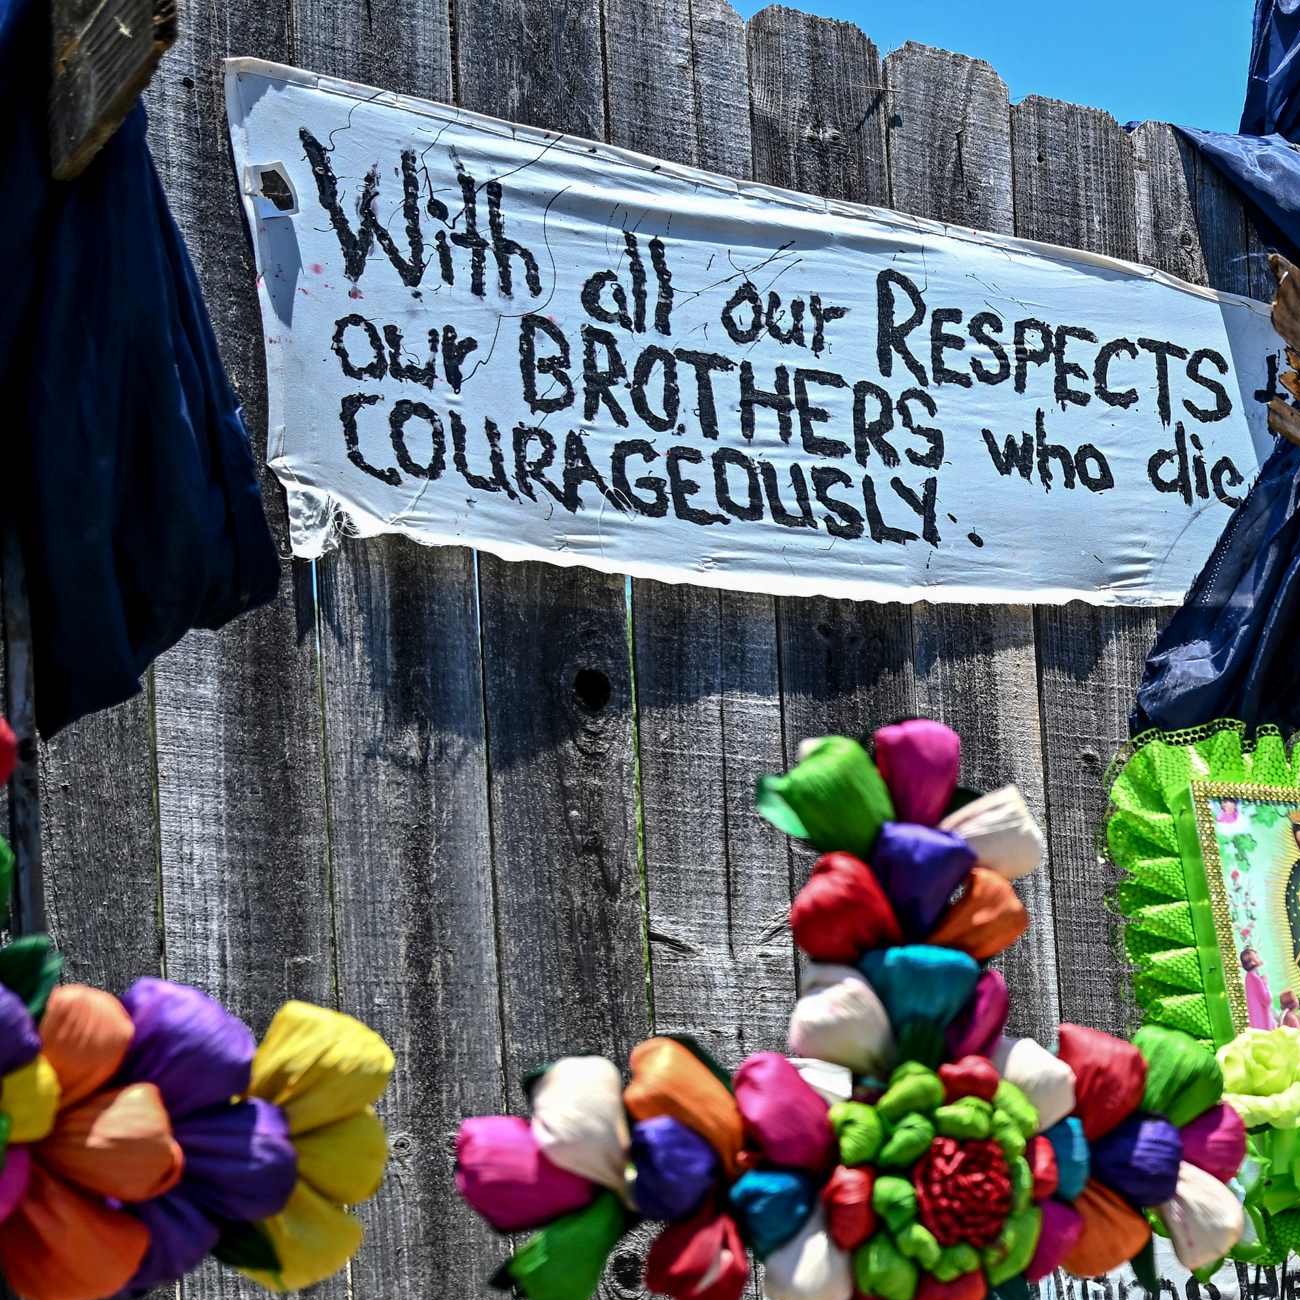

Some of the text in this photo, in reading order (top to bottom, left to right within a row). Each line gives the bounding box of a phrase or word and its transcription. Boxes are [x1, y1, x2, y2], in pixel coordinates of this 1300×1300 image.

[298, 126, 542, 298] With
[580, 229, 675, 336] all
[719, 280, 850, 357] our
[876, 267, 1232, 429] RESPECTS
[330, 313, 1248, 509] our BROTHERS who die
